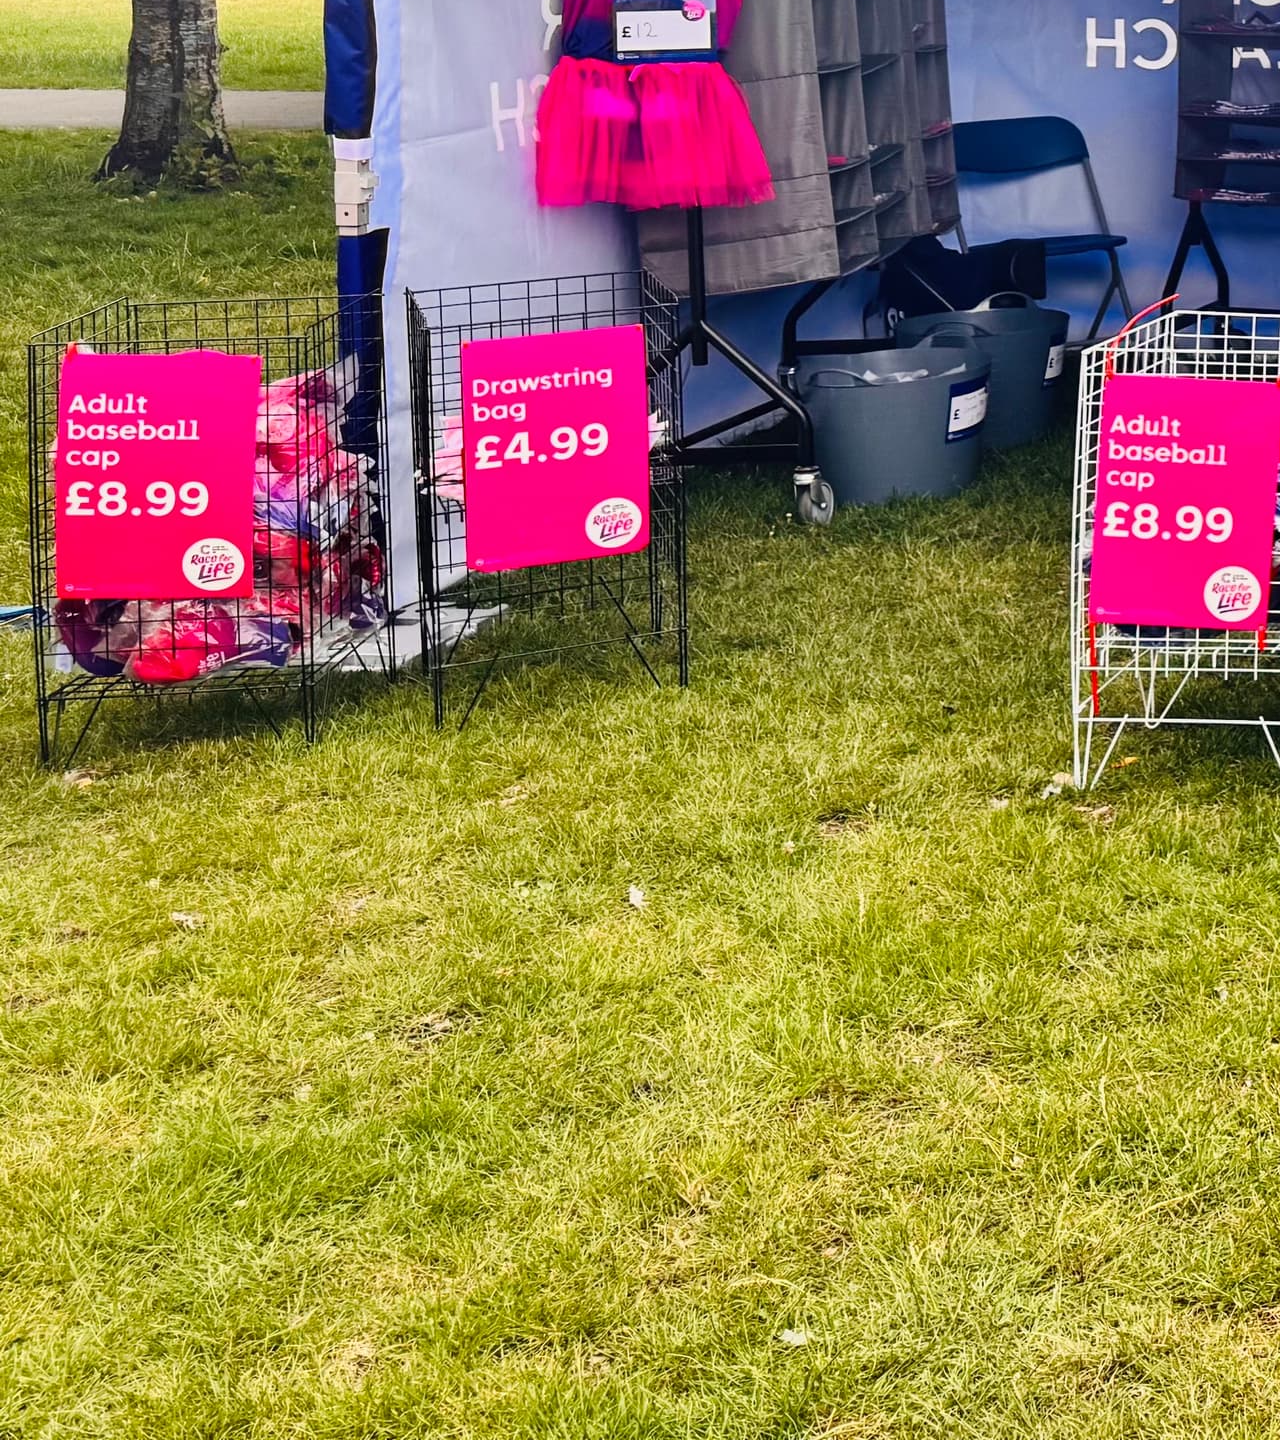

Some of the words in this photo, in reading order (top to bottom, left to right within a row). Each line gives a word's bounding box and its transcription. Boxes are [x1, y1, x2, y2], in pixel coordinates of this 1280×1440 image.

[472, 367, 613, 398] Drawstring
[68, 393, 148, 414] Adult
[471, 402, 527, 422] bag
[66, 419, 200, 441] baseball
[1109, 414, 1181, 437] Adult
[474, 422, 609, 470] £4.99
[1107, 439, 1228, 466] baseball
[65, 449, 120, 471] cap
[1105, 469, 1155, 492] cap
[65, 481, 209, 517] £8.99
[599, 518, 633, 539] Life
[1102, 501, 1234, 543] £8.99
[190, 554, 218, 566] Race
[198, 562, 235, 580] Life
[1212, 582, 1237, 594] Race
[1217, 592, 1252, 610] Life
